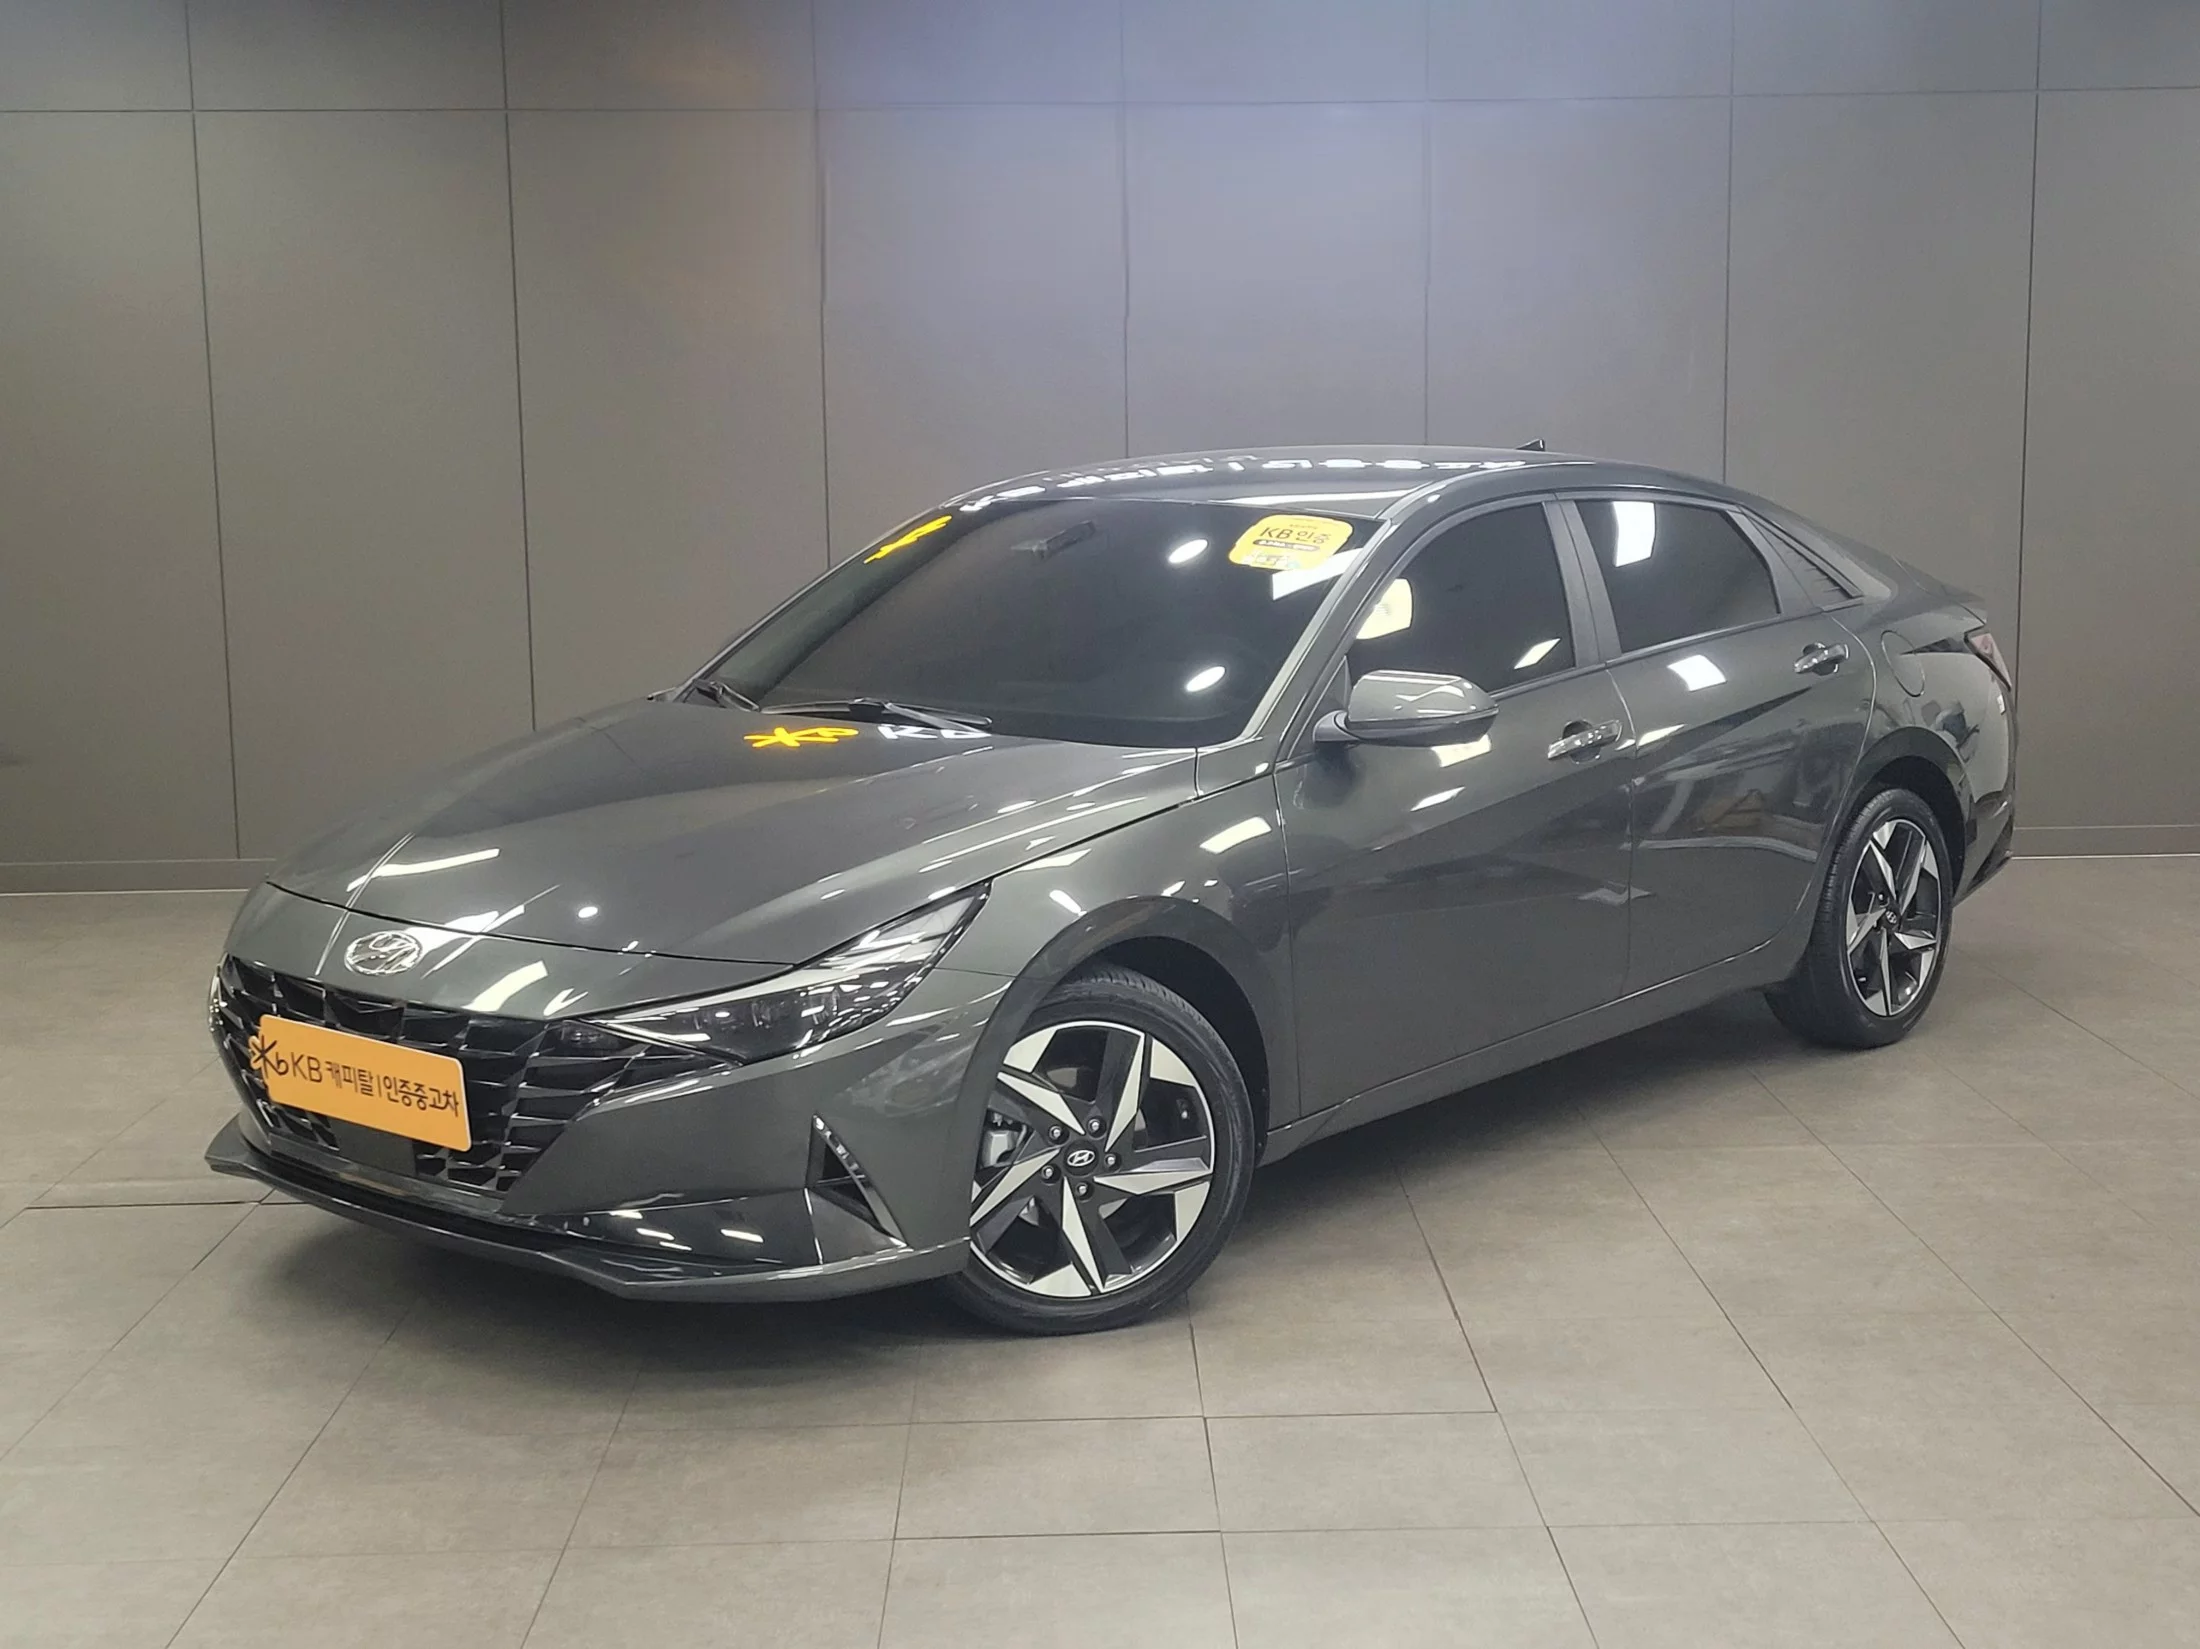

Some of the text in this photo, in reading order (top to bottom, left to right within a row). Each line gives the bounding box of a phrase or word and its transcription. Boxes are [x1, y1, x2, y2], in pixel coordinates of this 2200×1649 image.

[1260, 527, 1293, 540] KB
[290, 1052, 459, 1117] KB 캐피탈 인증중고차
